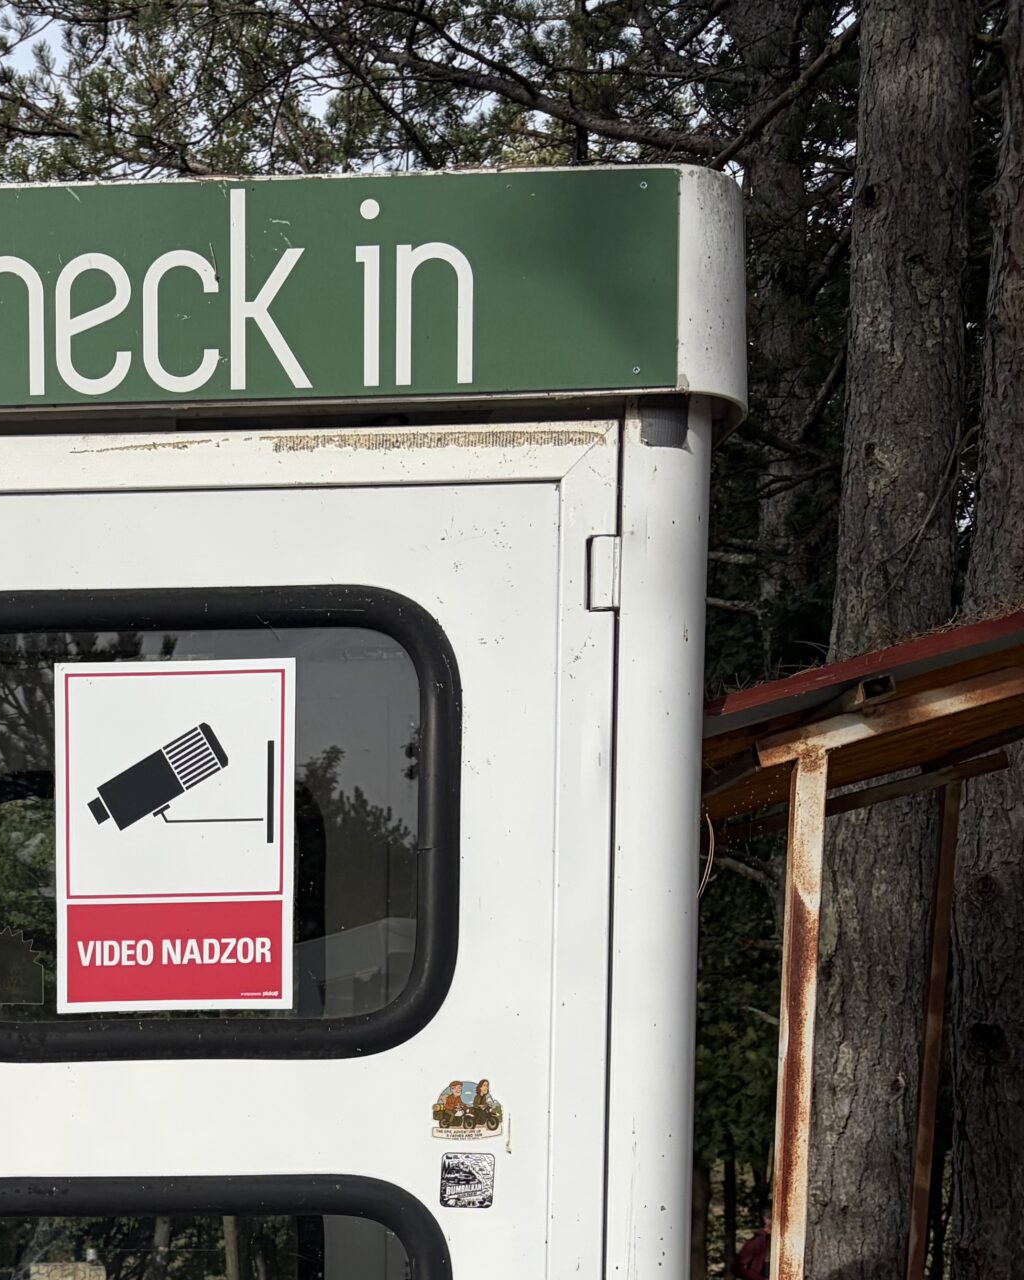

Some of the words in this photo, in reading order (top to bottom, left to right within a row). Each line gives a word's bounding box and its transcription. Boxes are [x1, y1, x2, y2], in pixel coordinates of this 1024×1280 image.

[356, 198, 474, 386] in
[77, 939, 153, 967] VIDEO
[162, 937, 272, 965] NADZOR
